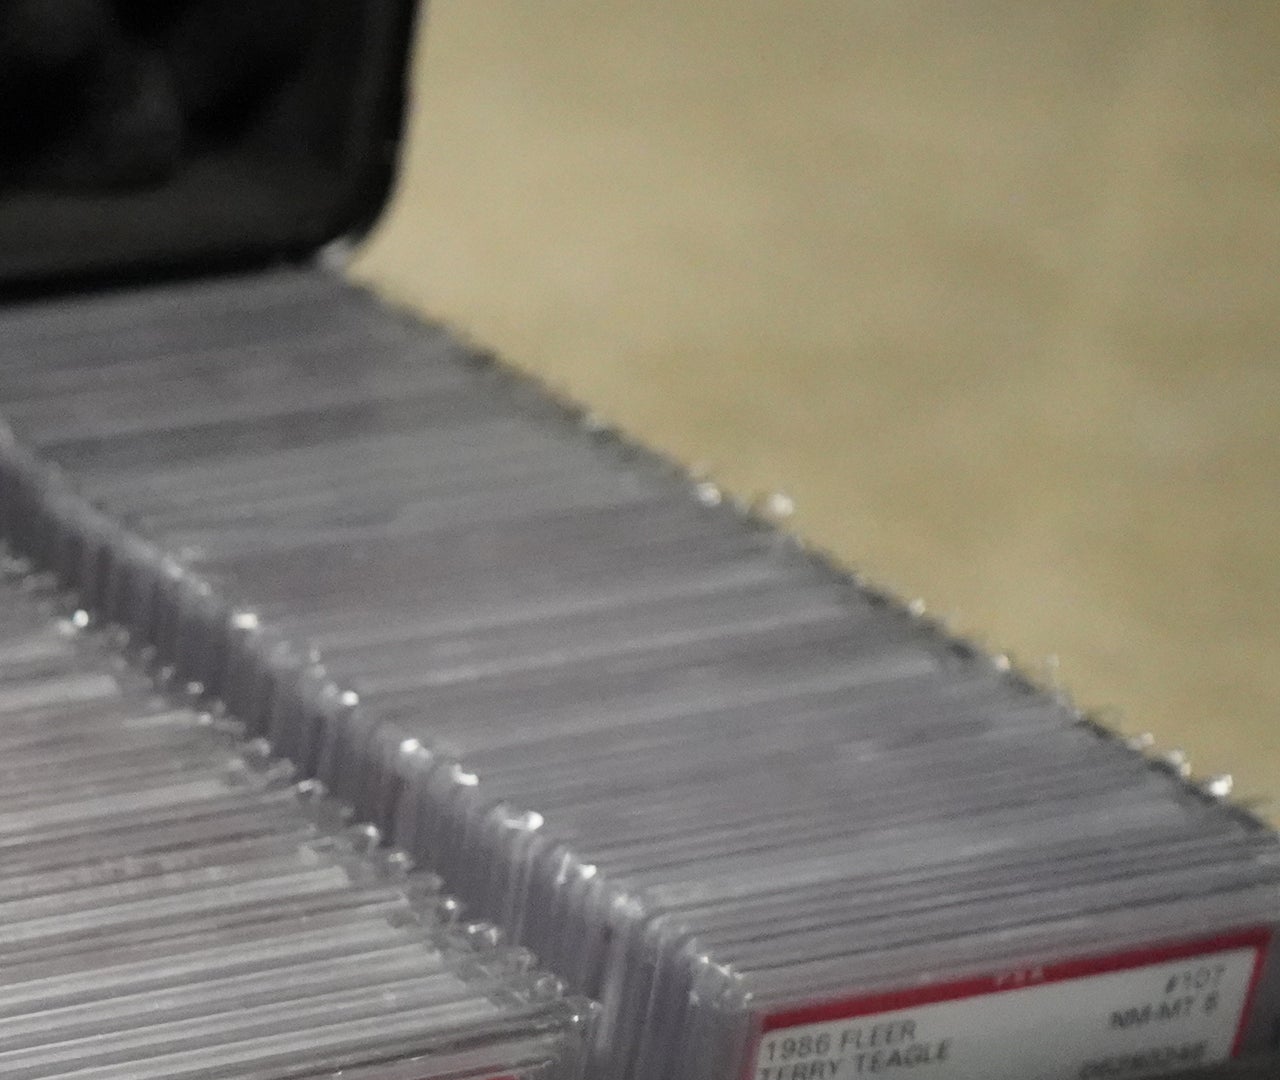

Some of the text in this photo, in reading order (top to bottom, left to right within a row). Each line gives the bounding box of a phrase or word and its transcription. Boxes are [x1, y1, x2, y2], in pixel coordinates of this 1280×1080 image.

[766, 1018, 918, 1062] 1986 FLEER
[853, 1038, 953, 1074] TEAGLE
